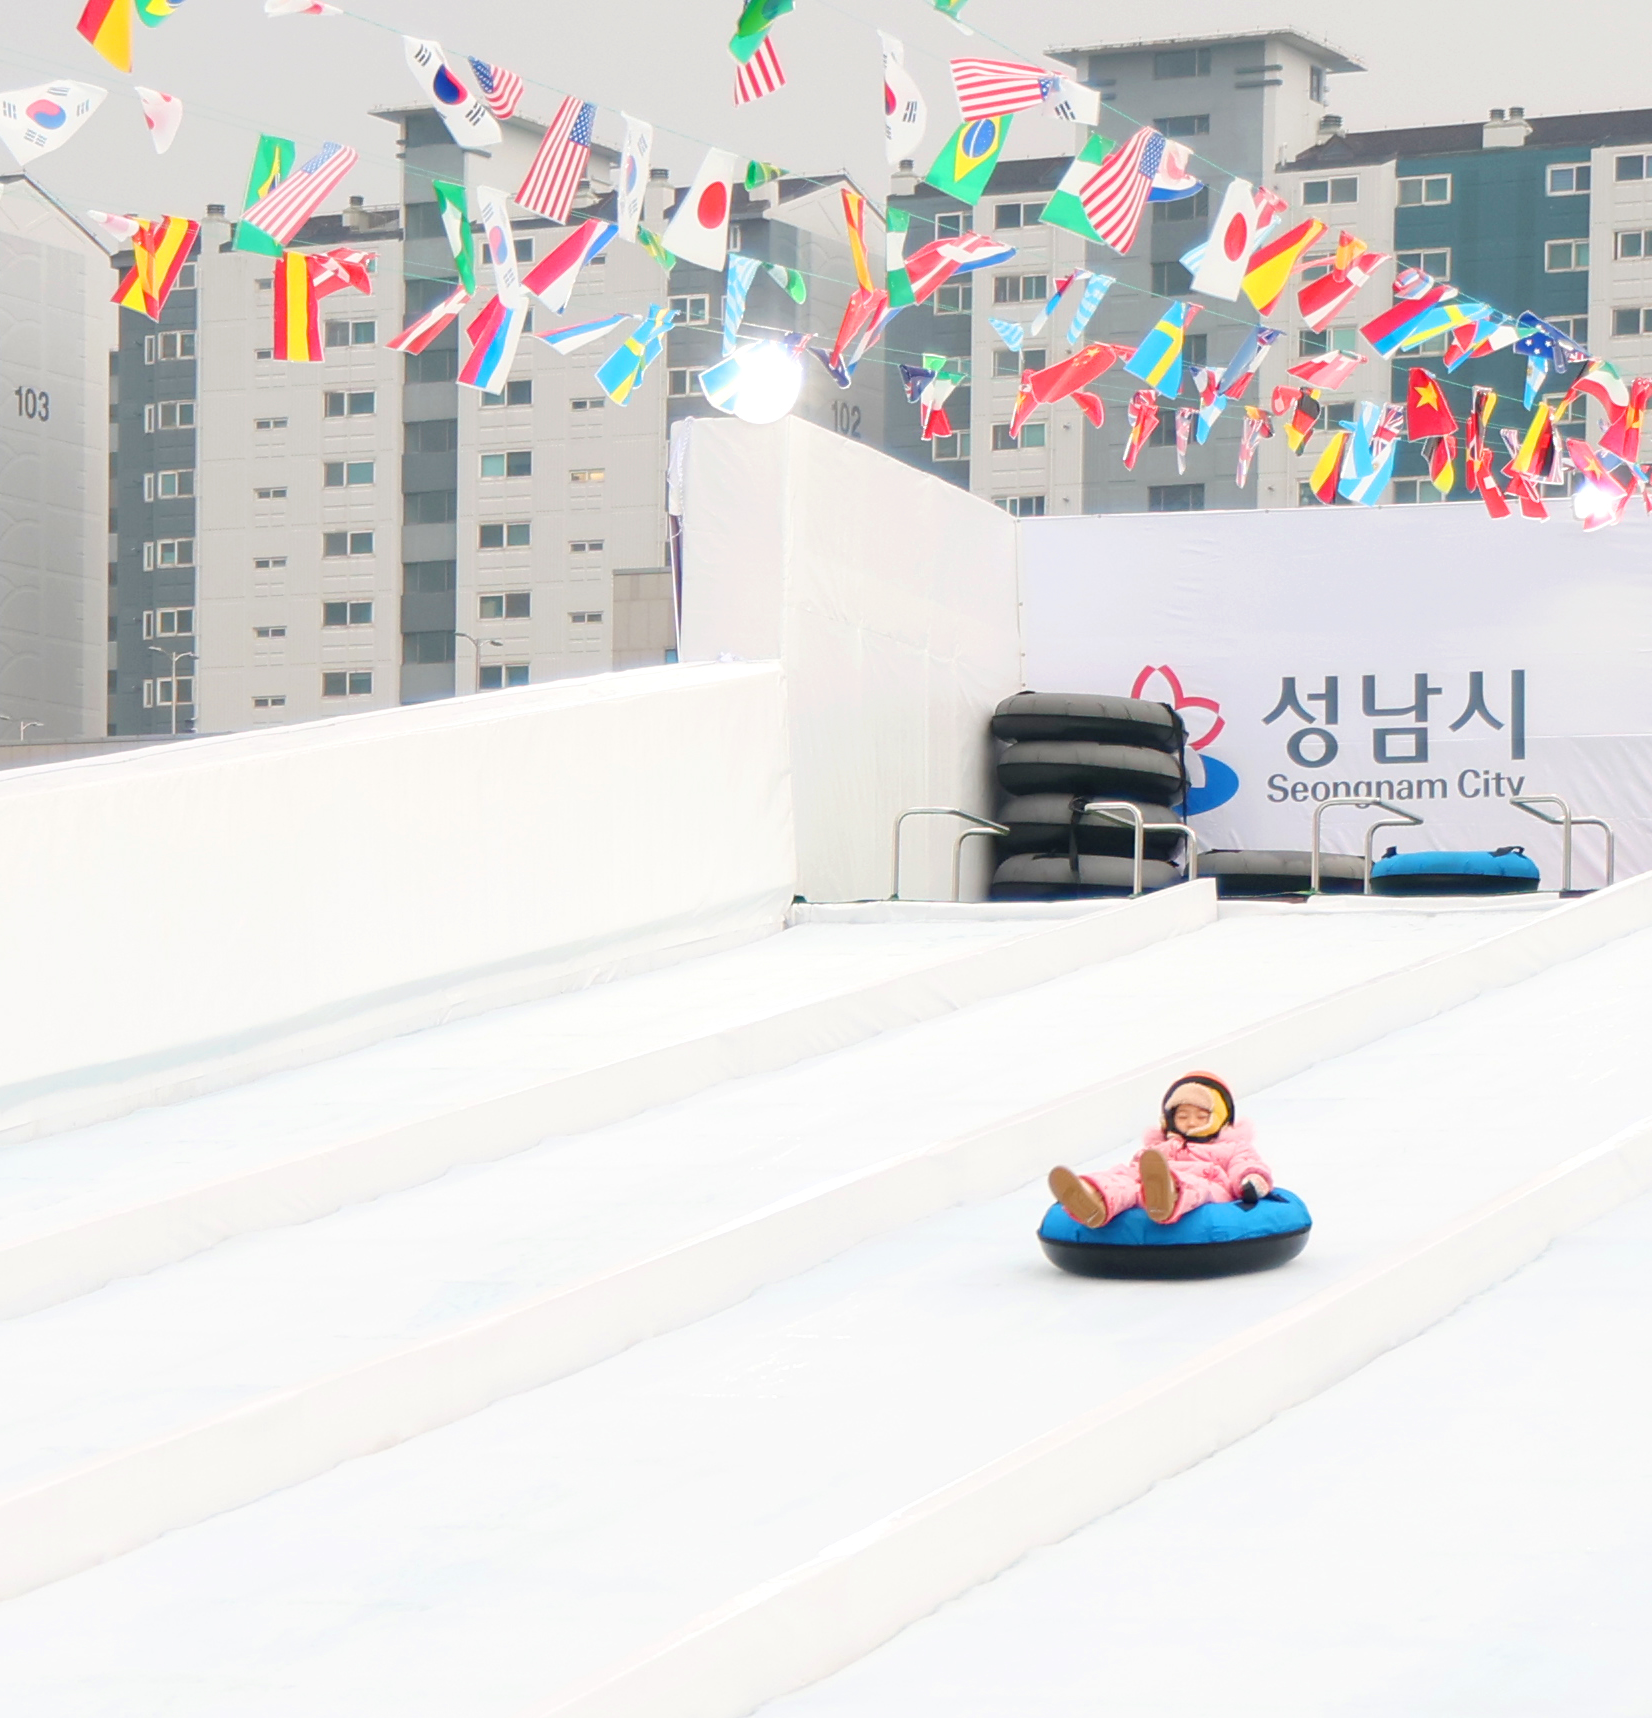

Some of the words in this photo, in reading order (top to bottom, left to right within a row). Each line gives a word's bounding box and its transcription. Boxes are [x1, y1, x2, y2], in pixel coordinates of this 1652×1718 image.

[14, 385, 50, 422] 103
[831, 399, 862, 439] 102
[1261, 668, 1526, 769] 성남시
[1266, 777, 1448, 809] Seongnam
[1457, 768, 1526, 799] City
